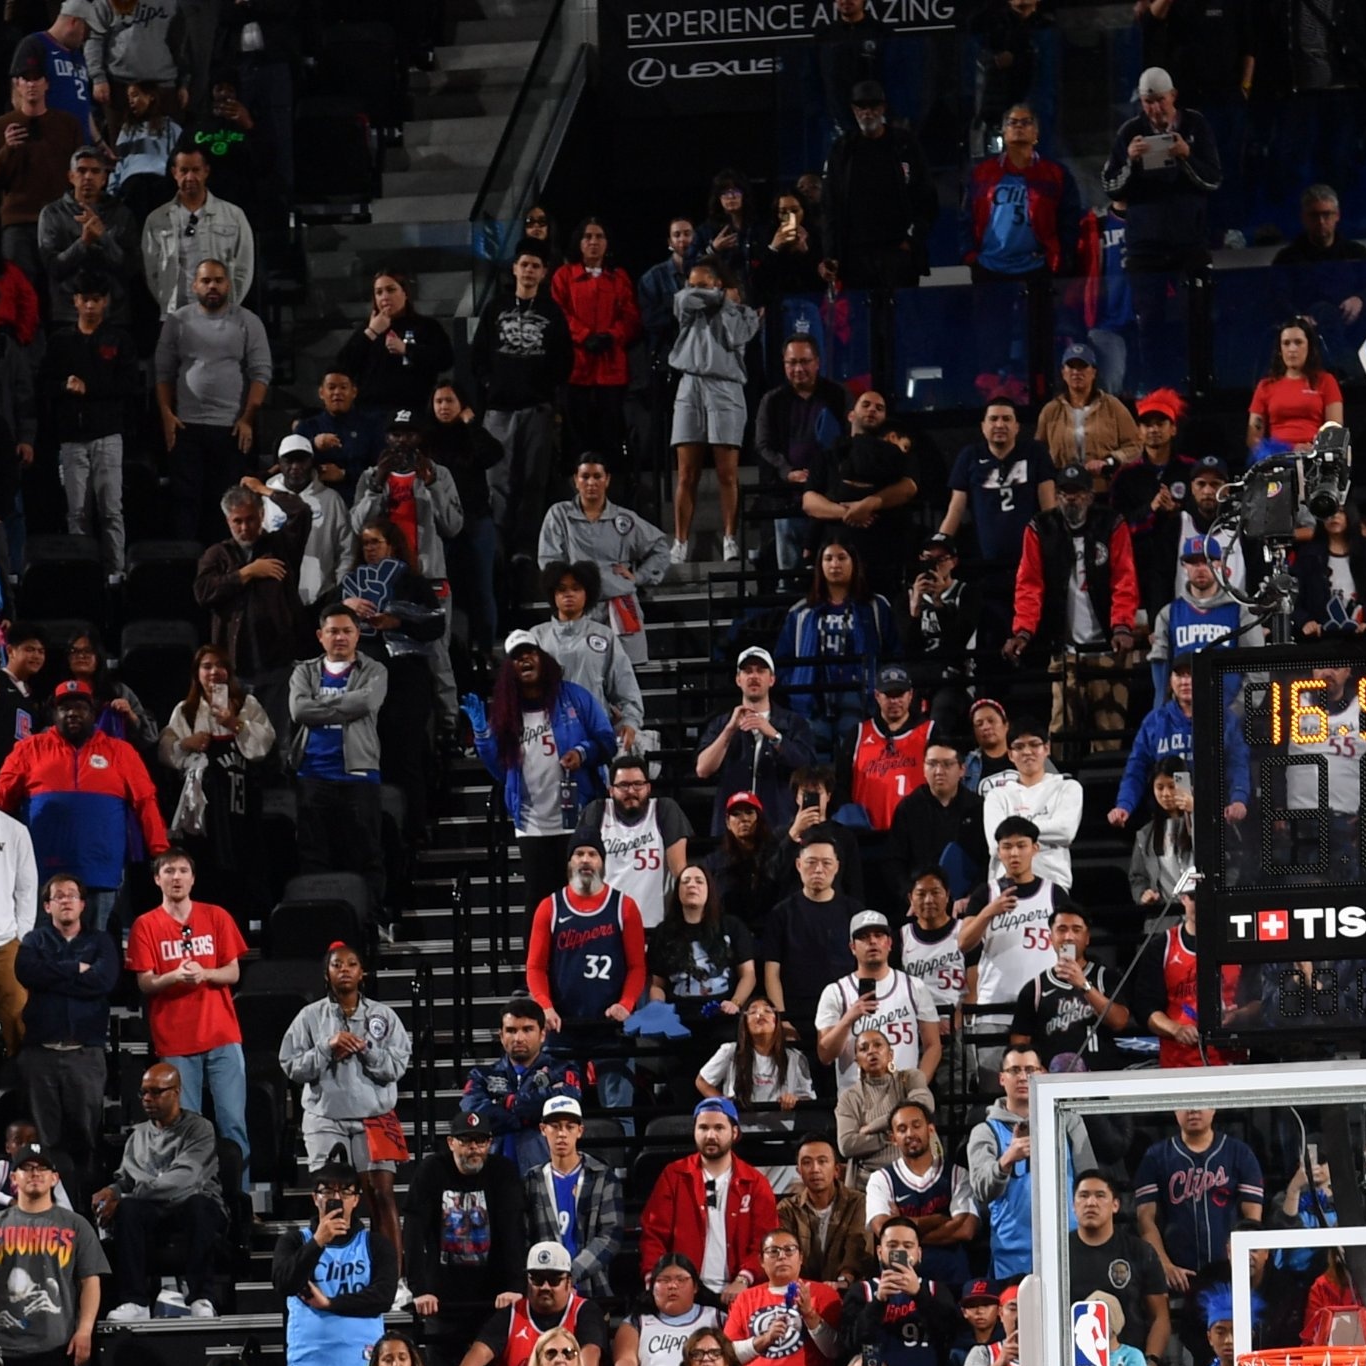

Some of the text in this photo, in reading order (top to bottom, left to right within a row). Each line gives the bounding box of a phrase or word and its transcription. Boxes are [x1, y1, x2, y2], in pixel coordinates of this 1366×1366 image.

[627, 0, 955, 40] EXPERIENCE AZING
[669, 57, 782, 79] LEXUS
[1000, 487, 1015, 512] 2
[633, 847, 660, 871] 55
[990, 904, 1050, 932] Clippers
[555, 922, 616, 951] Clippers
[1022, 926, 1051, 950] 55
[583, 953, 613, 981] 32
[936, 968, 965, 992] 55
[886, 1023, 914, 1046] 55
[1168, 1167, 1229, 1204] Clips
[311, 1261, 366, 1285] Clips
[648, 1334, 688, 1355] Clipp
